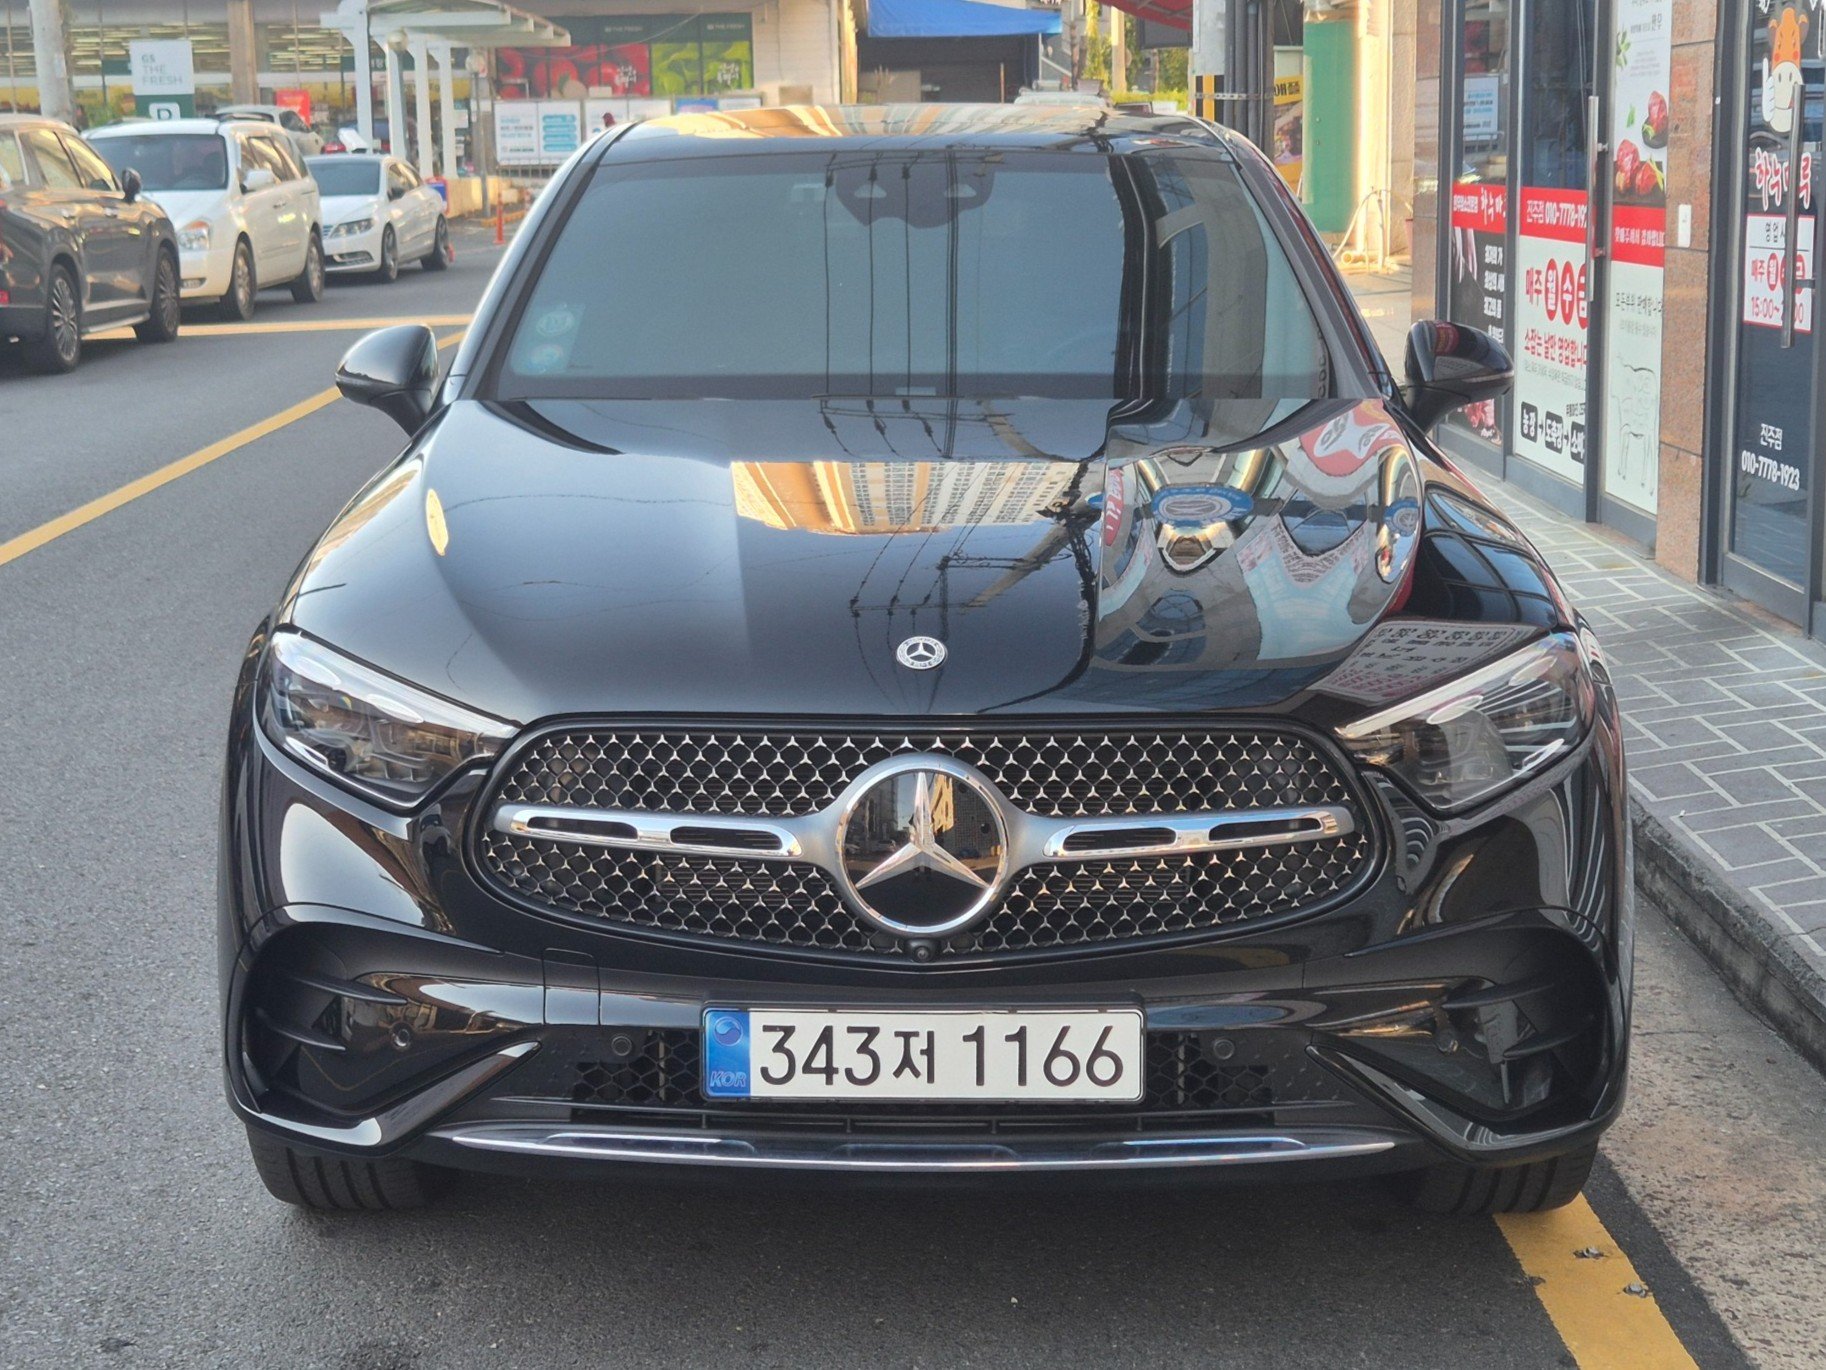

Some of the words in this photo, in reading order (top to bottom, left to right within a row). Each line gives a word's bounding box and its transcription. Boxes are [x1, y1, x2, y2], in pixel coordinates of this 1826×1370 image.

[142, 54, 156, 64] GS
[142, 65, 166, 74] THE
[142, 75, 183, 85] FRESH
[1526, 199, 1545, 223] 진주점
[1751, 259, 1765, 283] 매주
[1526, 268, 1542, 306] 매주
[1546, 269, 1557, 311] 월
[1562, 273, 1573, 314] 수
[1524, 328, 1542, 357] 소잡는
[1543, 331, 1556, 361] 날만
[1522, 408, 1536, 437] 농장
[1545, 418, 1563, 449] 도축장
[1760, 423, 1783, 450] 진주점
[1741, 449, 1800, 491] 010-7778-1923
[759, 1024, 935, 1086] 343저
[962, 1024, 1124, 1087] 1166
[709, 1070, 747, 1088] KOR
